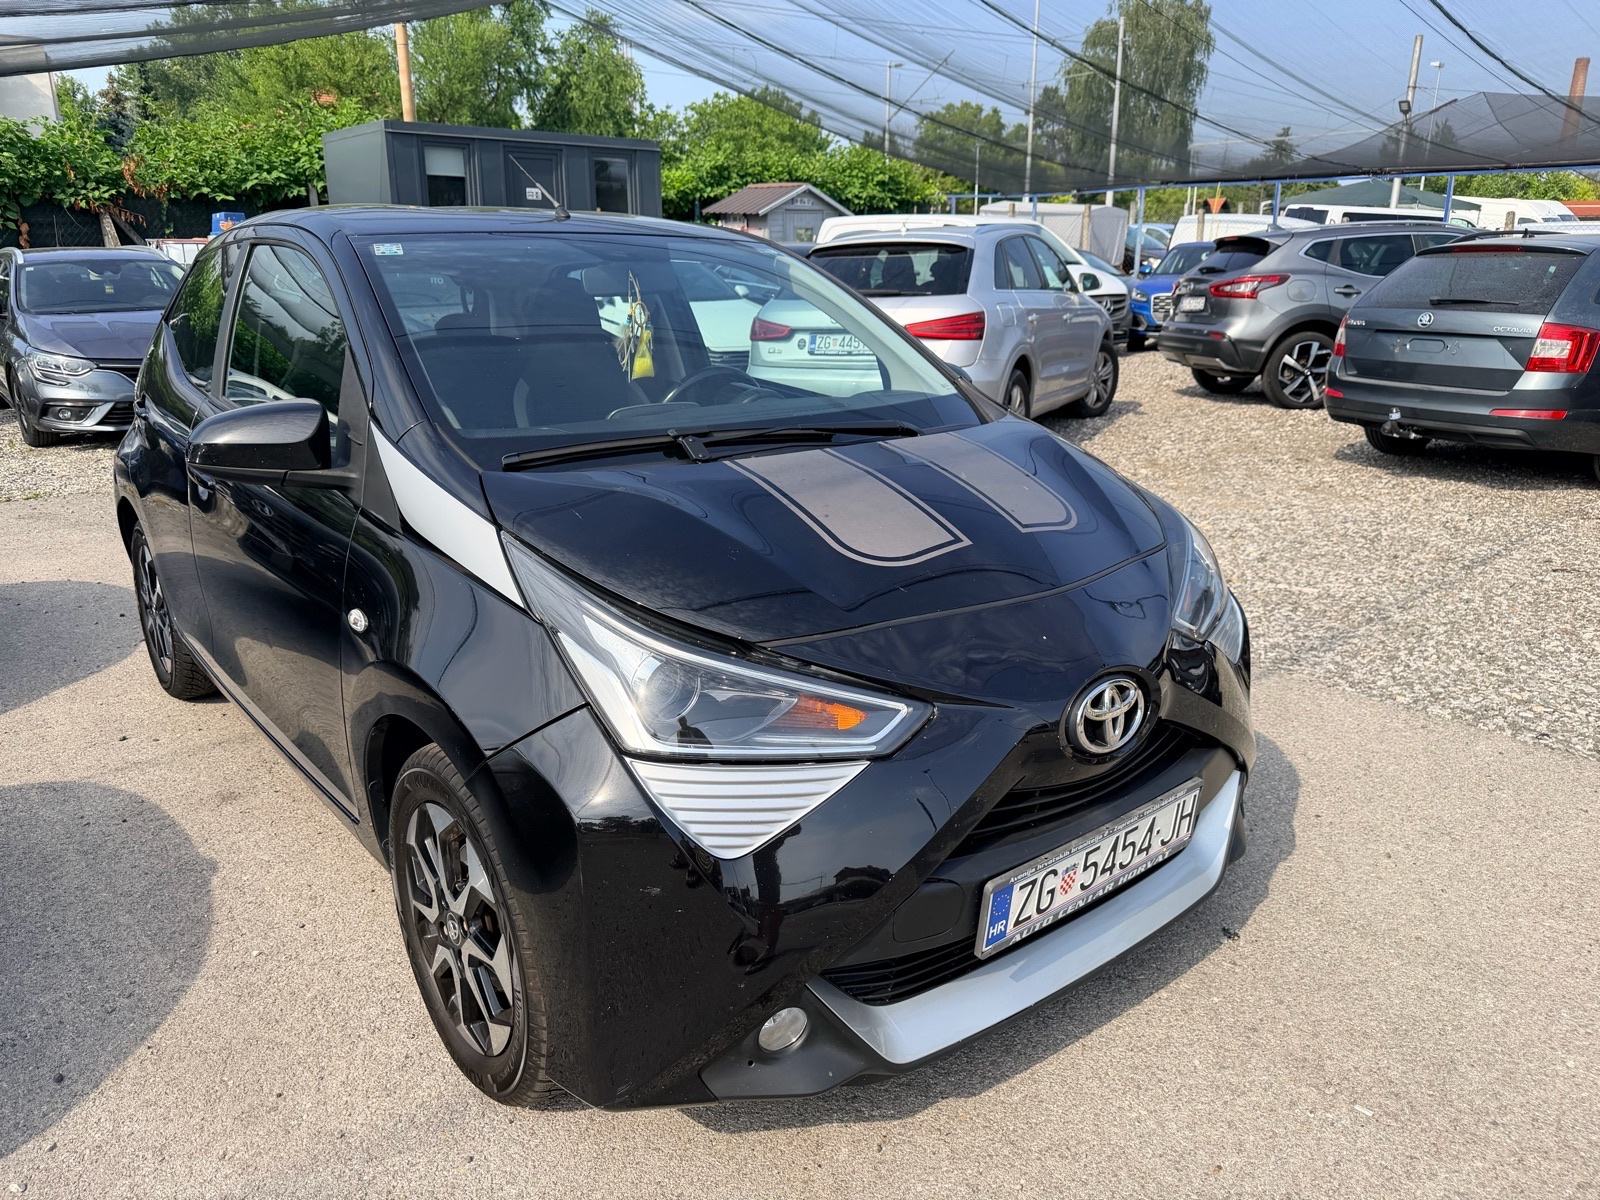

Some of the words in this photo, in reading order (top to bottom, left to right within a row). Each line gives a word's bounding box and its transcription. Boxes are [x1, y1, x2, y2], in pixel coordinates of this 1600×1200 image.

[817, 336, 831, 349] ZG
[1009, 915, 1054, 945] AUTO
[1058, 882, 1115, 919] CENTAR
[1118, 848, 1173, 886] HORVAT
[1012, 868, 1058, 929] ZG
[988, 920, 1006, 939] HR
